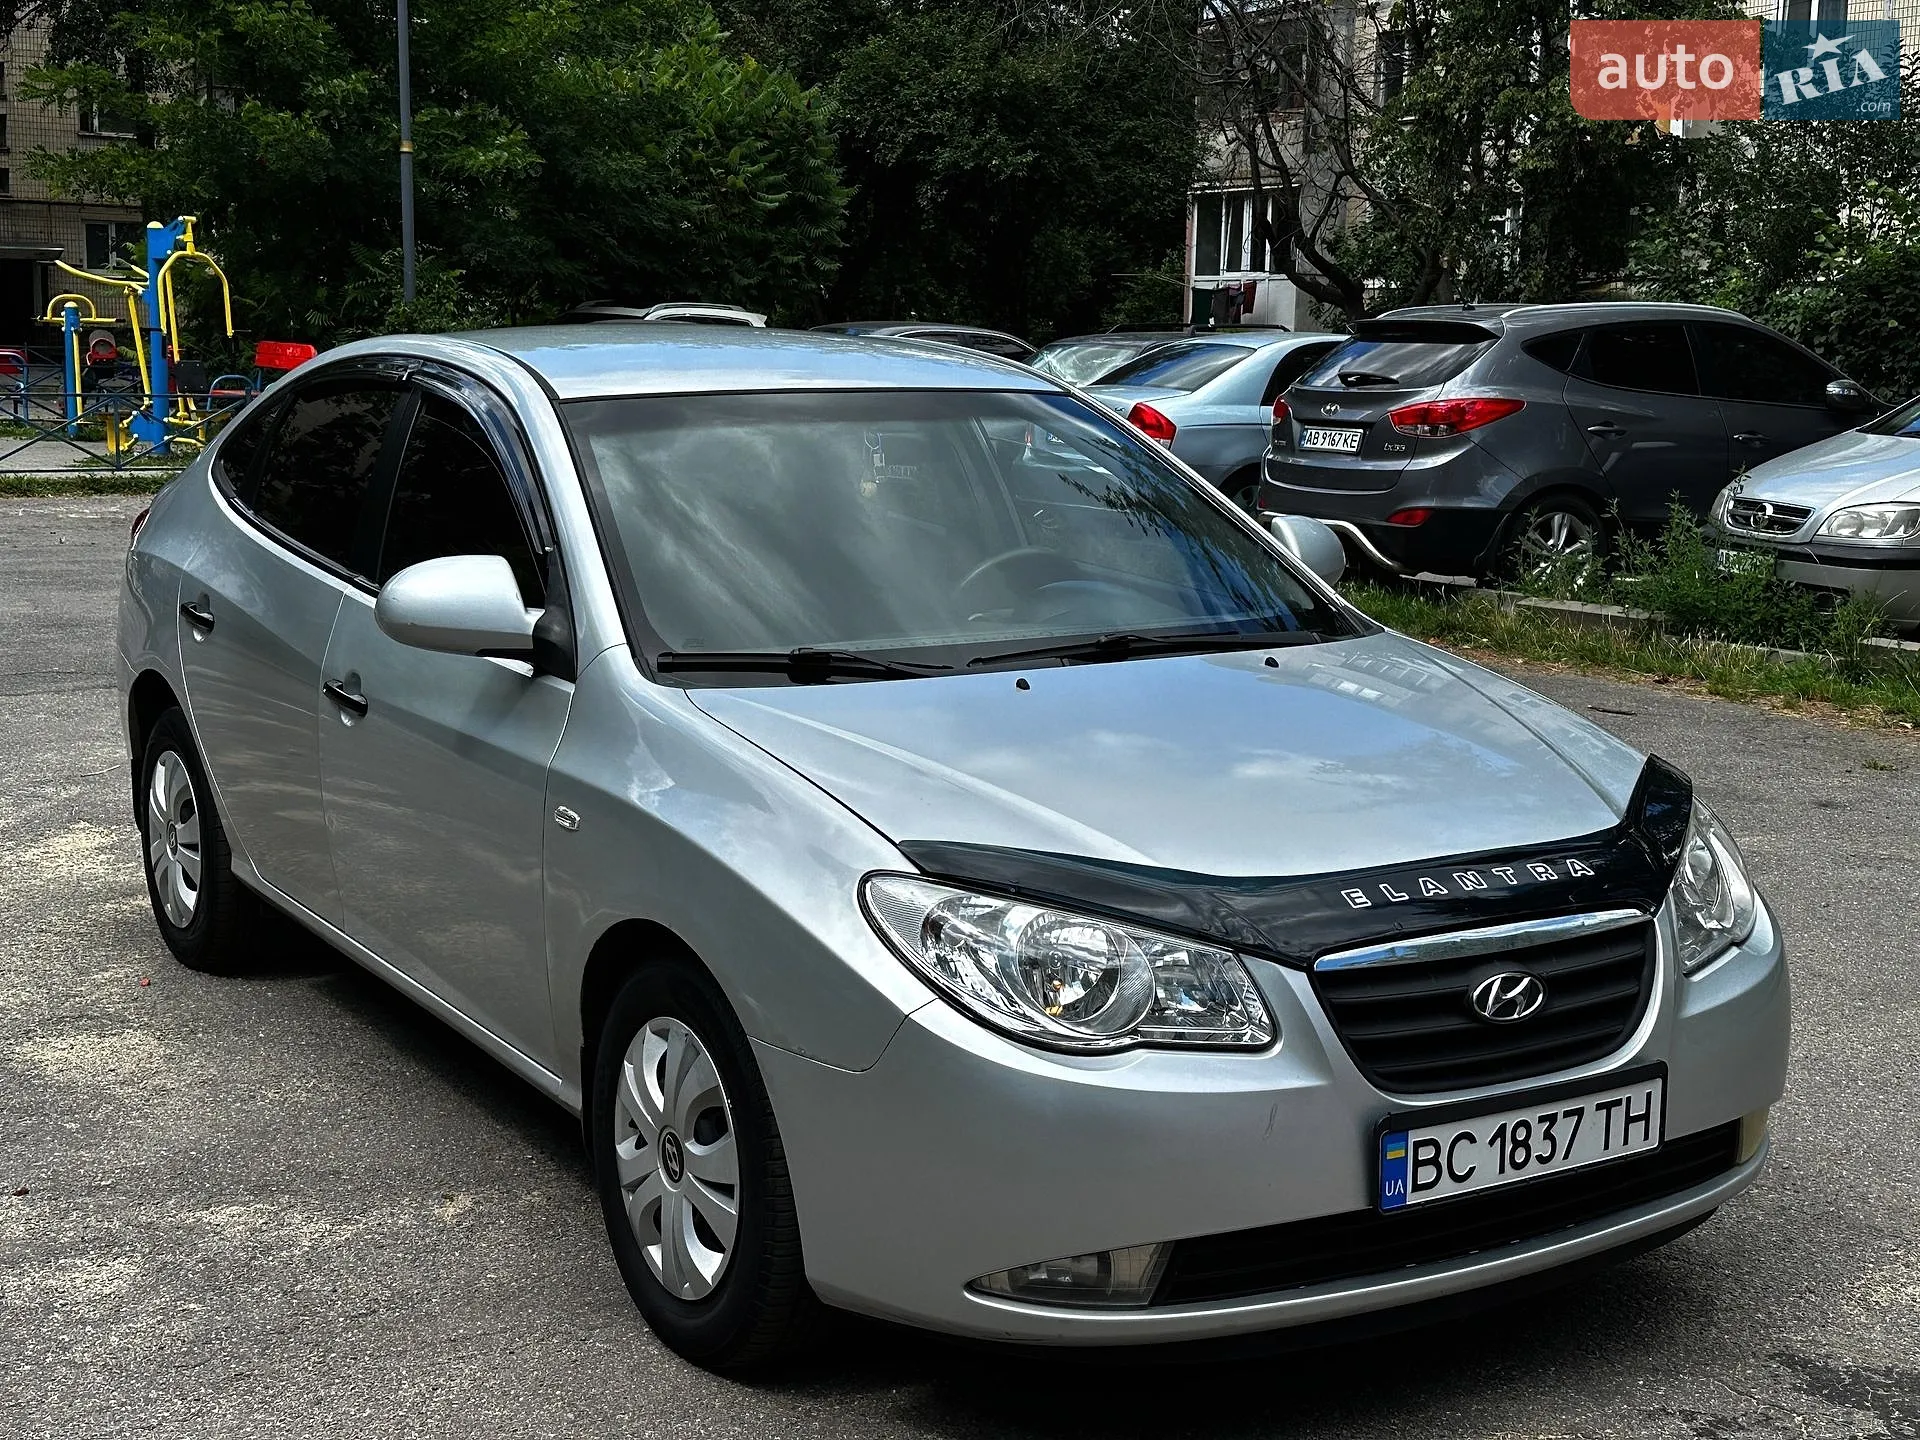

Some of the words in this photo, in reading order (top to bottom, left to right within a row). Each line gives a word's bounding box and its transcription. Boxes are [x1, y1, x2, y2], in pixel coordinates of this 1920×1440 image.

[1305, 431, 1320, 446] AB
[1320, 431, 1342, 447] 9167
[1342, 433, 1358, 449] KE
[1341, 858, 1595, 909] ELANTRA
[1411, 1129, 1478, 1193] BC
[1487, 1106, 1585, 1175] 1837
[1595, 1089, 1653, 1151] TH
[1385, 1179, 1404, 1196] UA
